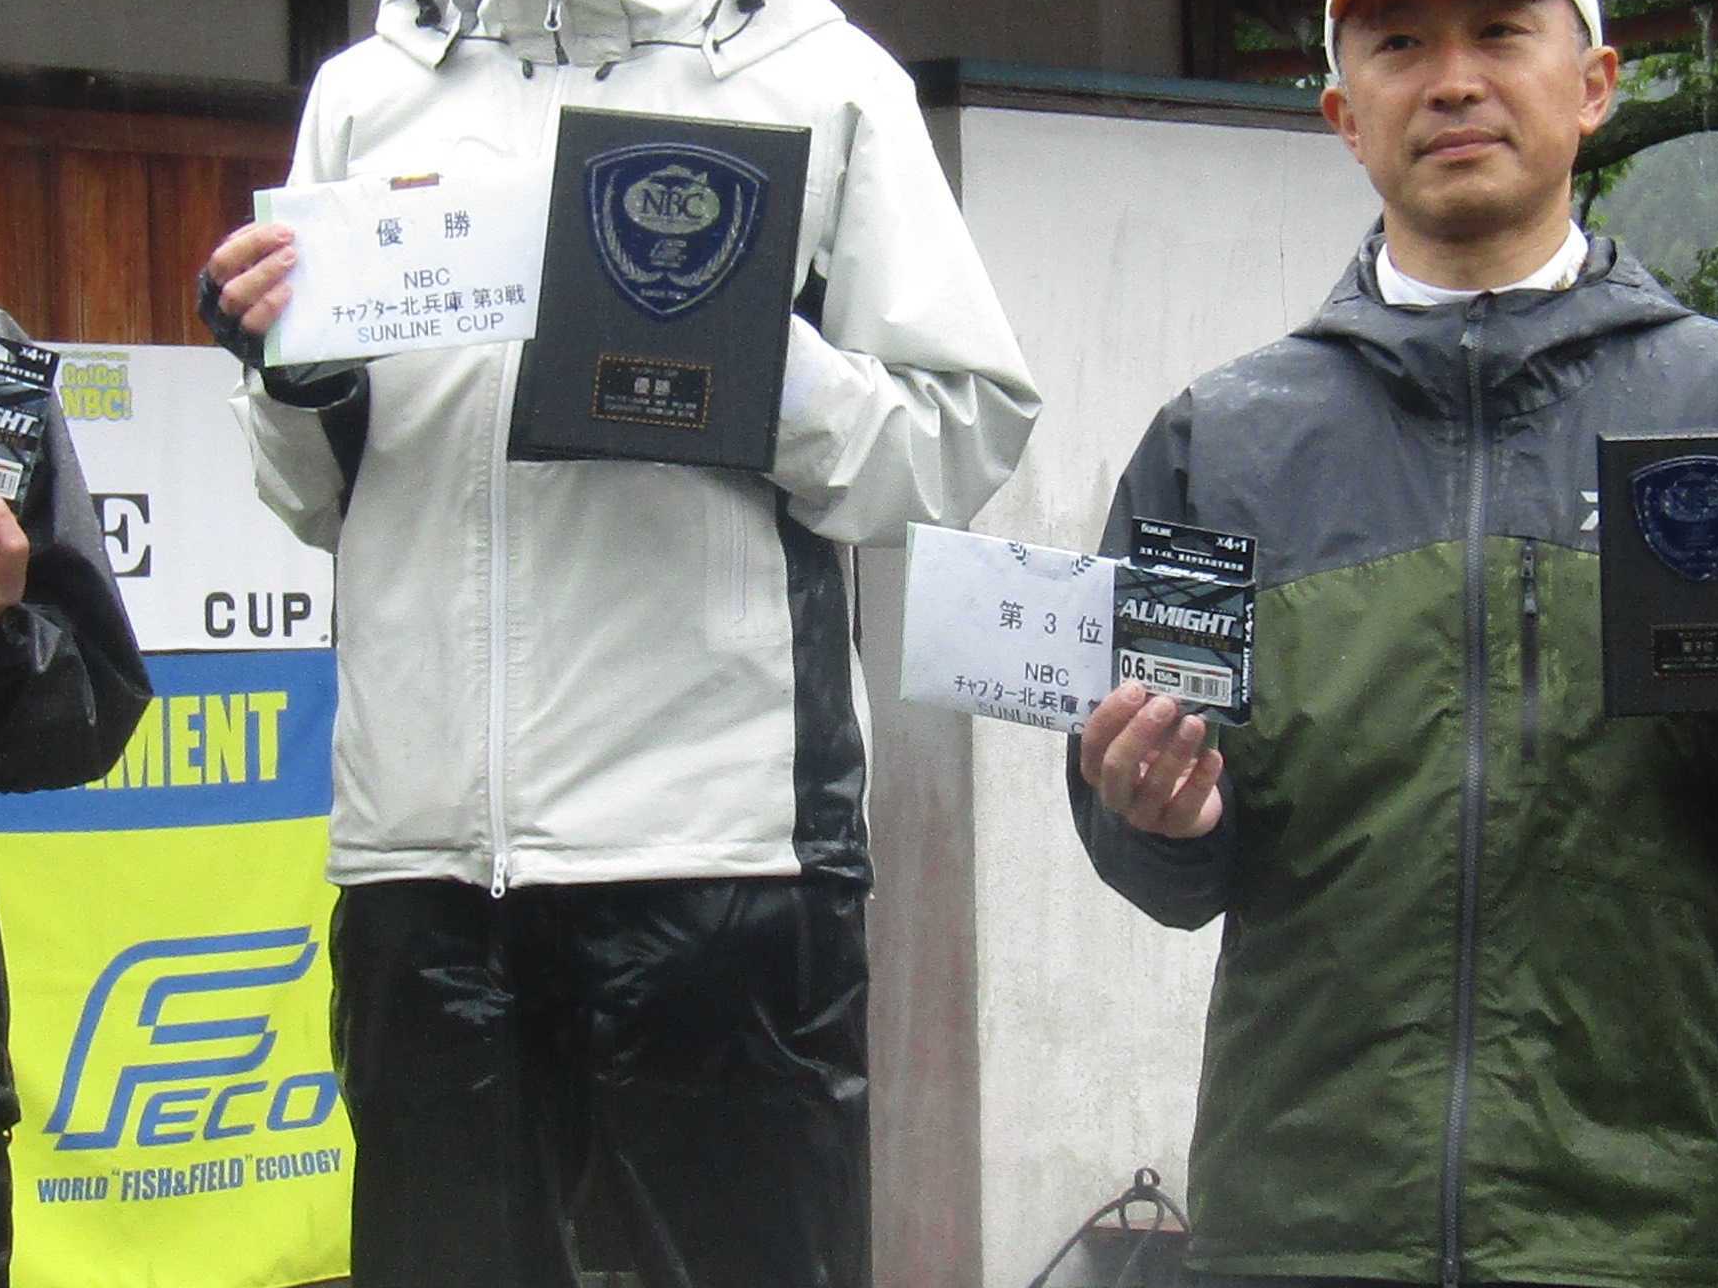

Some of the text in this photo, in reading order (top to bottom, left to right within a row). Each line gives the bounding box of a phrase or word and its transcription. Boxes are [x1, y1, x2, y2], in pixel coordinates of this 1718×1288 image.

[642, 189, 705, 220] NBC
[403, 268, 450, 289] NBC
[472, 284, 526, 309] 第3戦
[358, 313, 504, 344] SUNLINE CUP
[204, 591, 312, 638] CUP
[1119, 598, 1237, 636] ALMIGHT
[1025, 662, 1070, 687] NBC
[37, 1169, 108, 1203] WORLD
[255, 1148, 343, 1183] ECOLOGY
